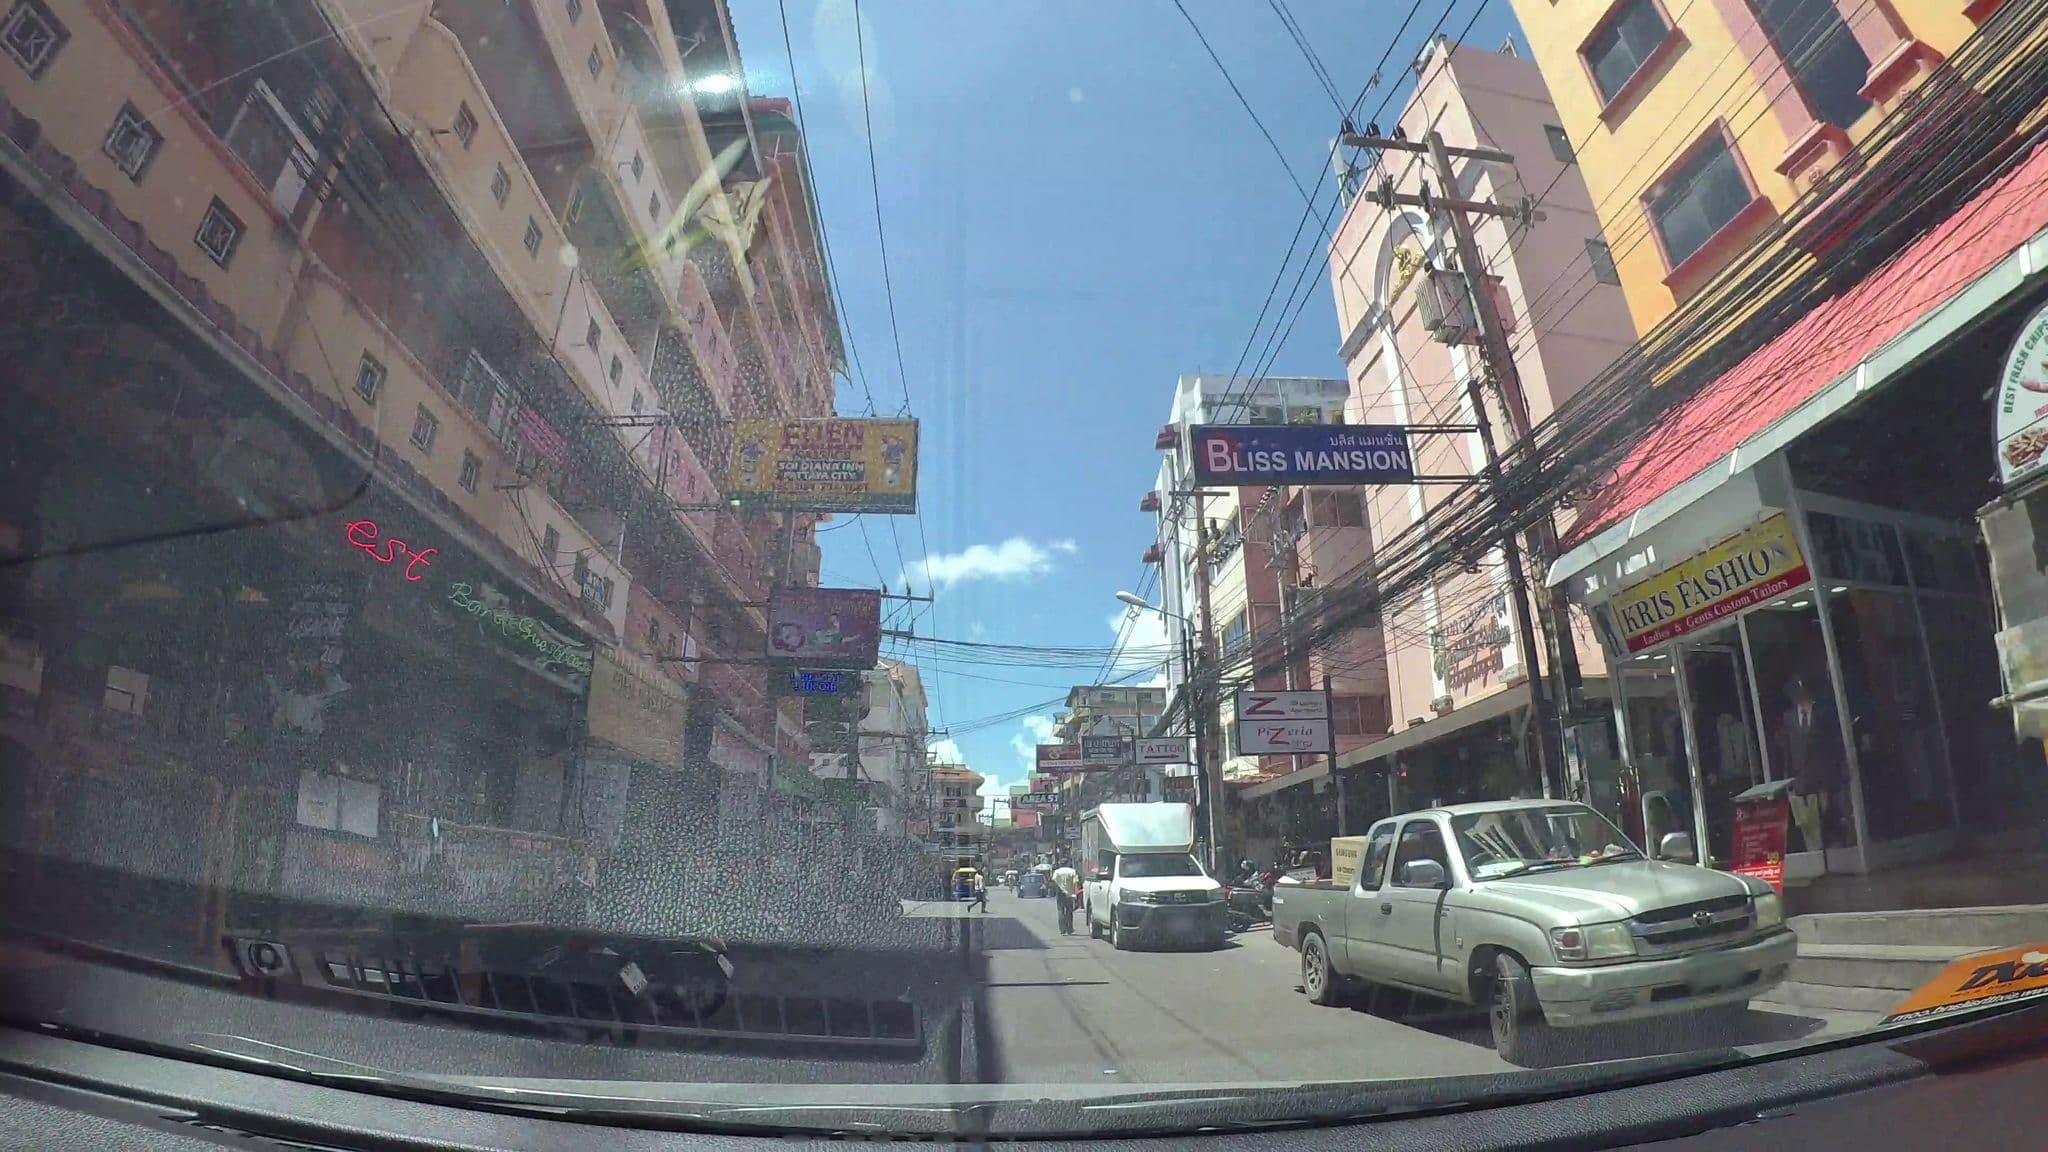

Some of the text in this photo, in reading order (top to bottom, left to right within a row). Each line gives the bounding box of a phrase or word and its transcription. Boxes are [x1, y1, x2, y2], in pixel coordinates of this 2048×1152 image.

[1330, 436, 1355, 446] บลิส
[1207, 440, 1408, 472] BLISS MANSION
[778, 461, 799, 472] SOI
[841, 461, 864, 472] INN
[784, 472, 829, 480] PATTAYA
[1621, 535, 1787, 633] KRIS FASHION
[1713, 595, 1750, 618] Custom
[1750, 579, 1789, 602] Tailors
[1138, 744, 1185, 754] TATTOO
